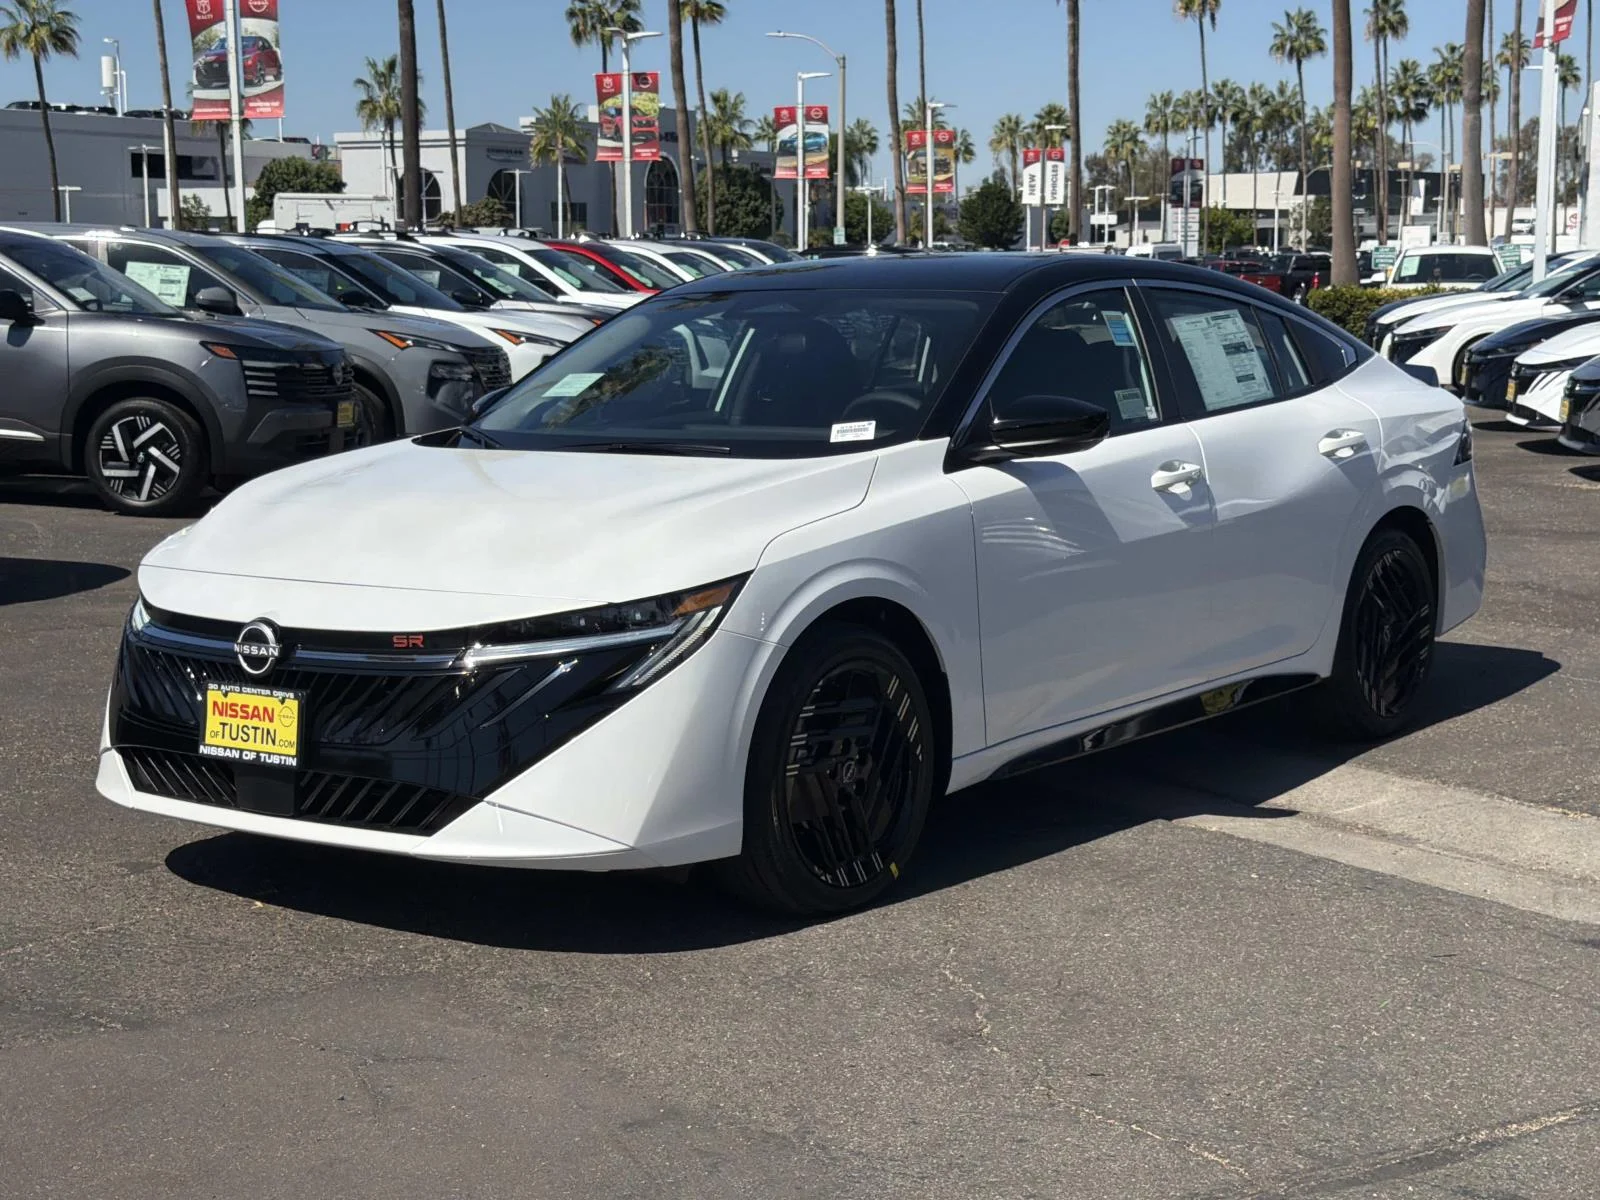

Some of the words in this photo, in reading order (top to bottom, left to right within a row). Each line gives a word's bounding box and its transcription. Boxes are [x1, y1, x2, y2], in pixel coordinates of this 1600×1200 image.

[1028, 173, 1036, 196] NEW
[1050, 164, 1058, 200] VEHICLES
[234, 644, 279, 657] NISSAN
[392, 635, 425, 648] SR
[221, 684, 240, 692] AUTO
[242, 687, 271, 695] CENTER
[212, 700, 275, 723] NISSAN
[209, 730, 220, 738] OF
[219, 722, 277, 746] TUSTIN
[199, 745, 240, 759] NISSAN
[242, 751, 258, 761] OF
[259, 753, 297, 767] TUSTIN
